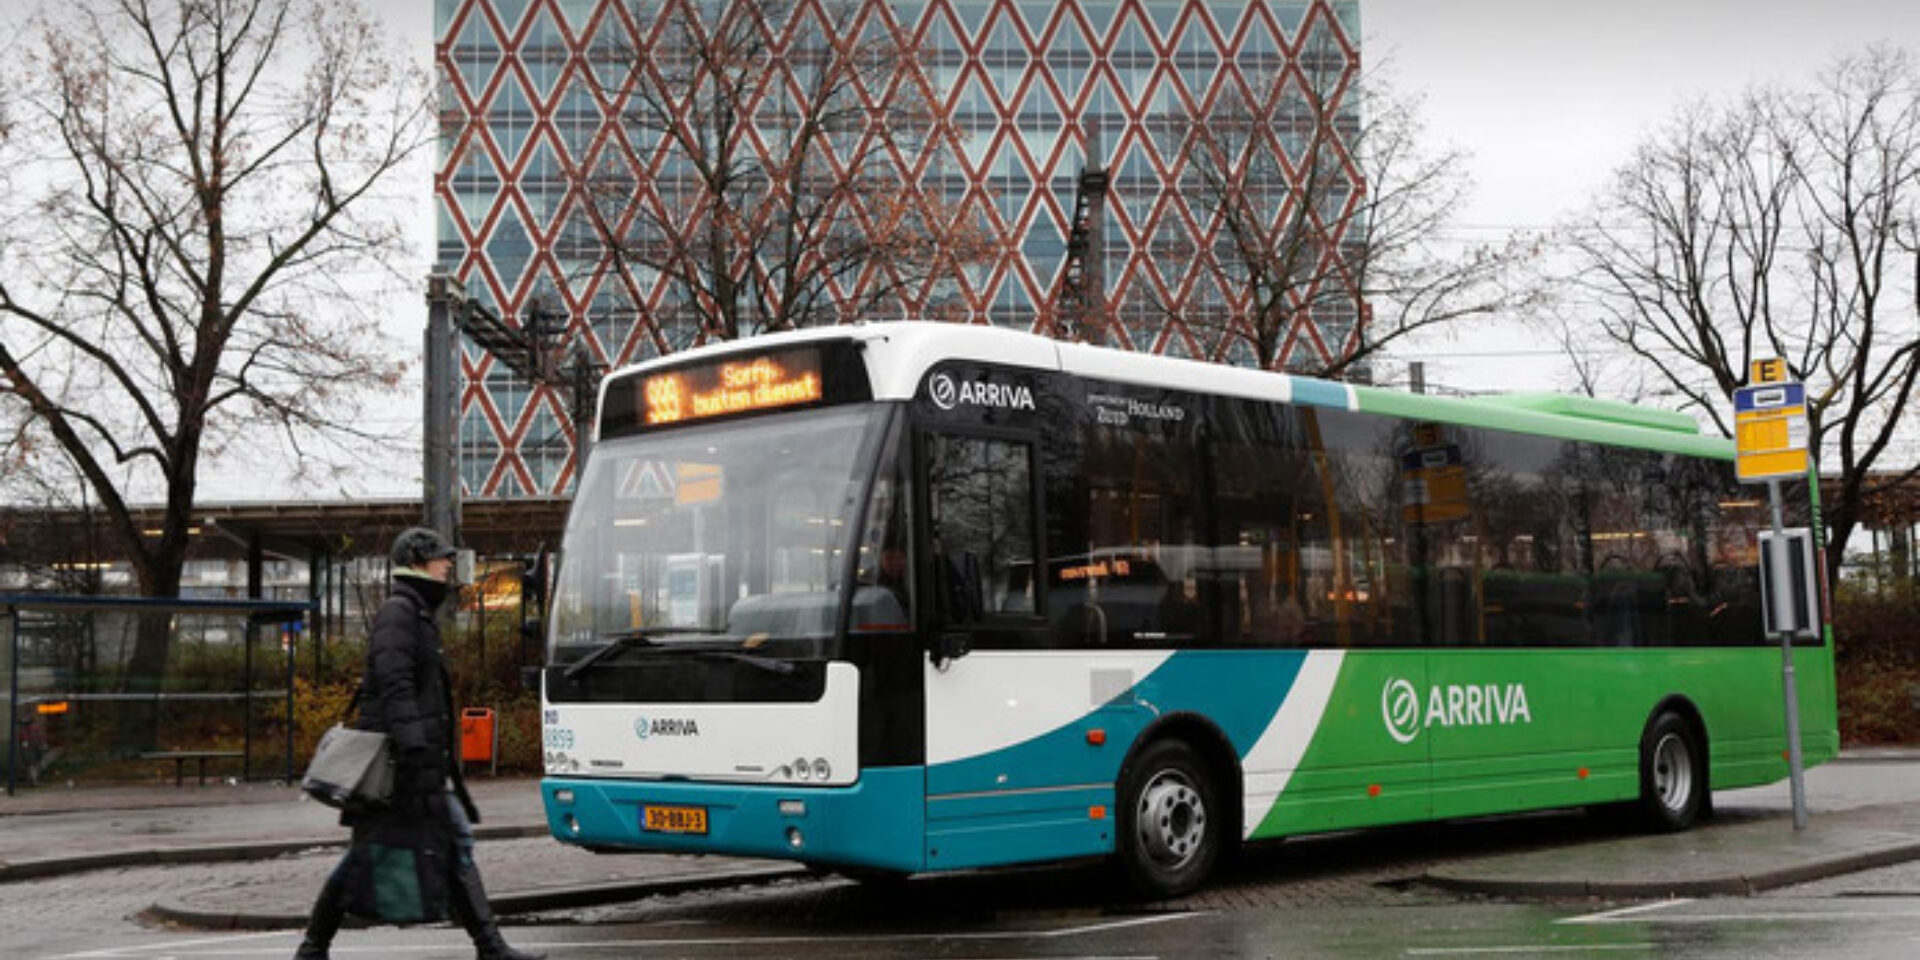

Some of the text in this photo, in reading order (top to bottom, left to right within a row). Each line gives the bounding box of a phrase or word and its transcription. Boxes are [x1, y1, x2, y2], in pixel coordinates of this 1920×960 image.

[1761, 359, 1777, 382] E
[754, 371, 815, 405] dienst
[959, 380, 1036, 411] ARRIVA
[1424, 683, 1532, 728] ARRIVA
[650, 718, 700, 737] ARRIVA
